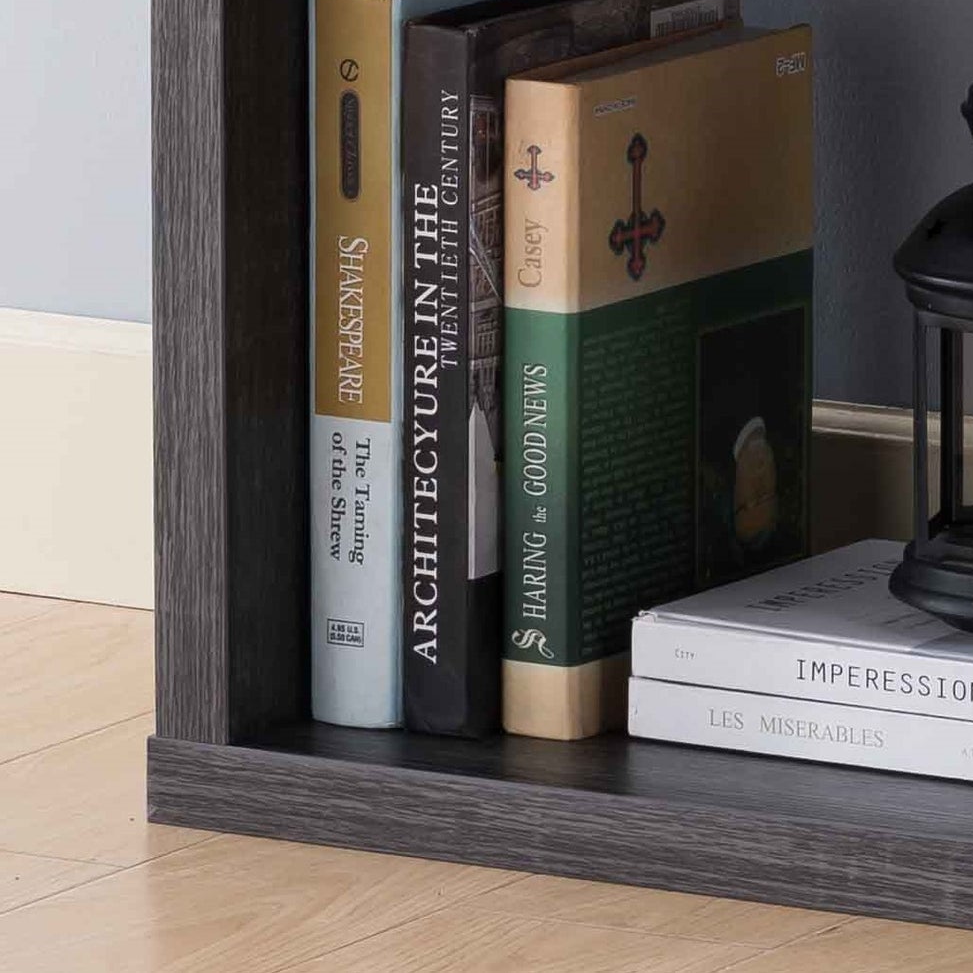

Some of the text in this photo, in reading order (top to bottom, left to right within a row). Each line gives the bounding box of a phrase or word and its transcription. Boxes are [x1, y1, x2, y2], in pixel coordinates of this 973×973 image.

[441, 89, 459, 369] TWENTIETH CENTURY
[517, 218, 549, 289] Casey
[338, 235, 369, 404] SHAKESPEARE
[413, 183, 438, 665] ARCHITECYURE IN THE
[523, 363, 547, 427] NEWS
[330, 431, 347, 561] of the Shrew
[349, 438, 370, 565] The Taming
[523, 431, 547, 496] GOOD
[532, 505, 547, 524] the
[709, 708, 886, 749] LES MISERABLES
